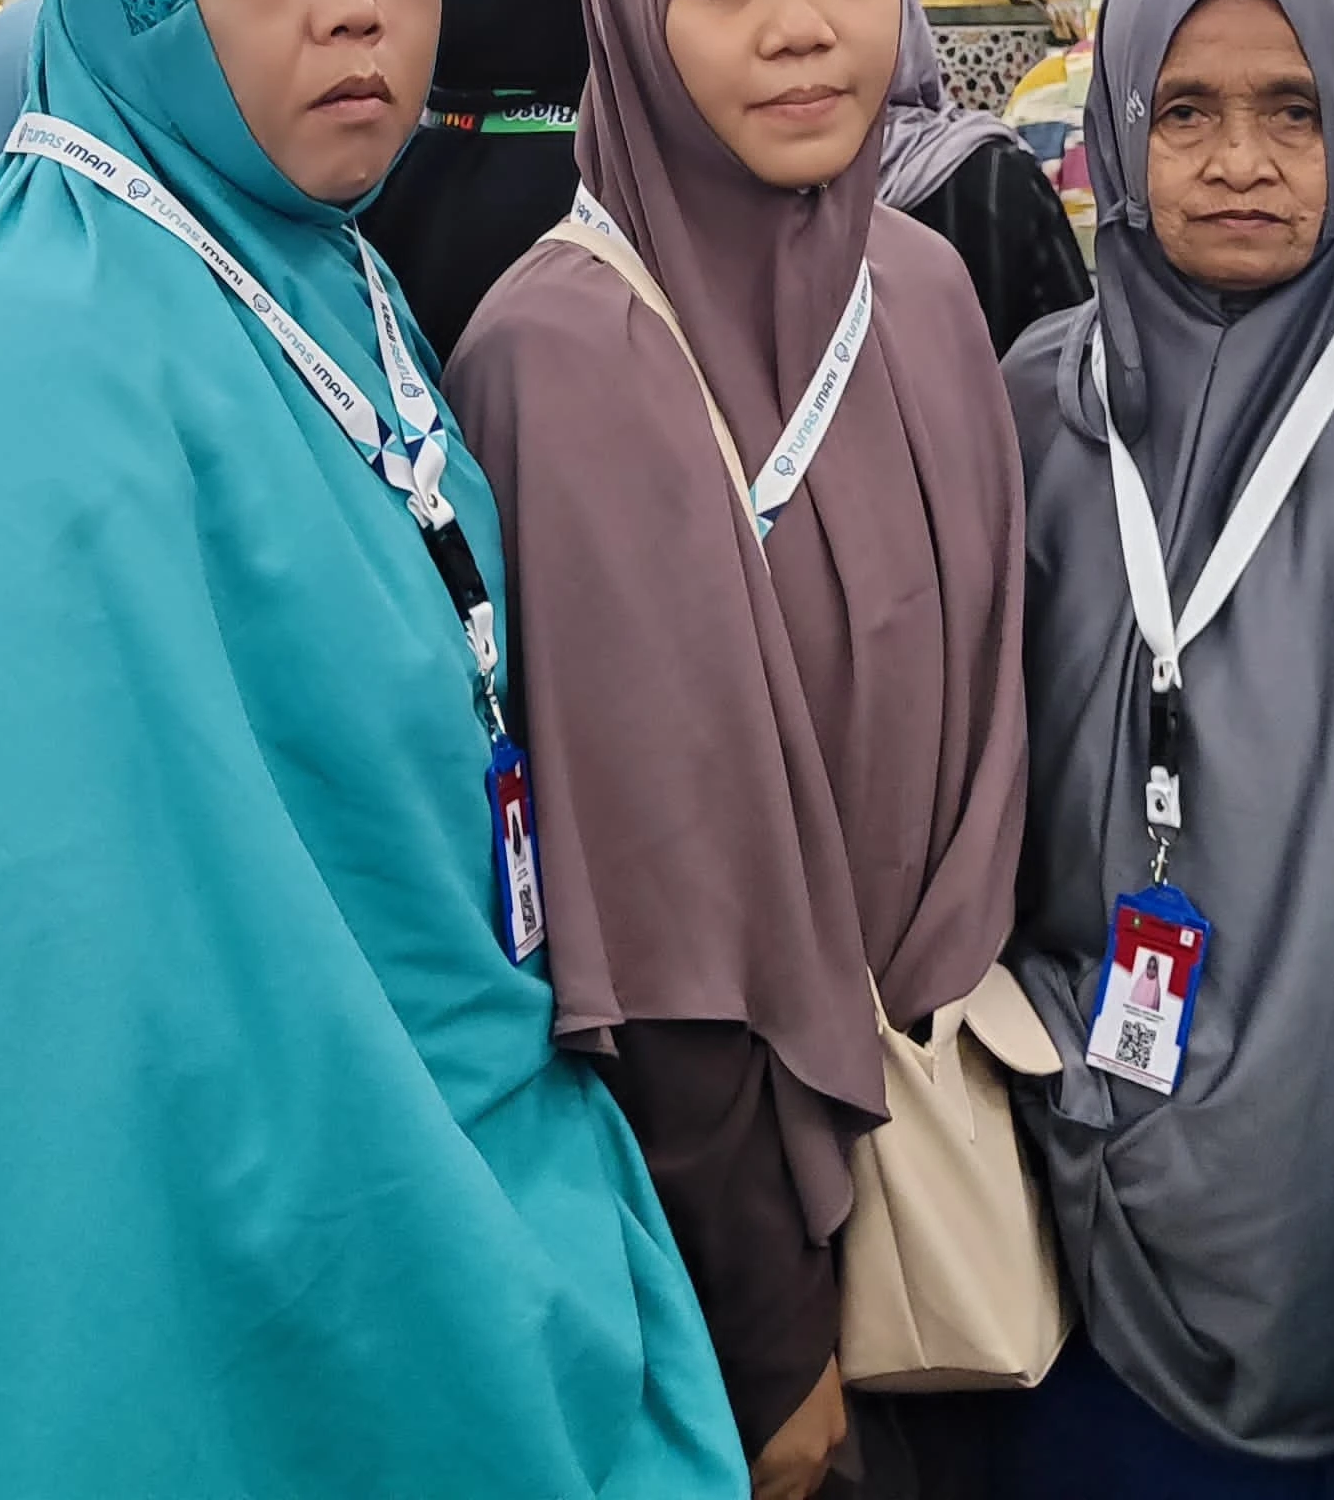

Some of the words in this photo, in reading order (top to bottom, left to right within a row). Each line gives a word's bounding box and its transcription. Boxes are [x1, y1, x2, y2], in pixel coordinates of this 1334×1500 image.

[63, 140, 118, 179] IMANI
[149, 194, 202, 244] TUNAS
[199, 239, 244, 287] IMANI
[268, 311, 315, 365] TUNAS
[311, 361, 355, 412] IMANI
[788, 410, 821, 455] TUNAS
[814, 370, 838, 411] IMANI
